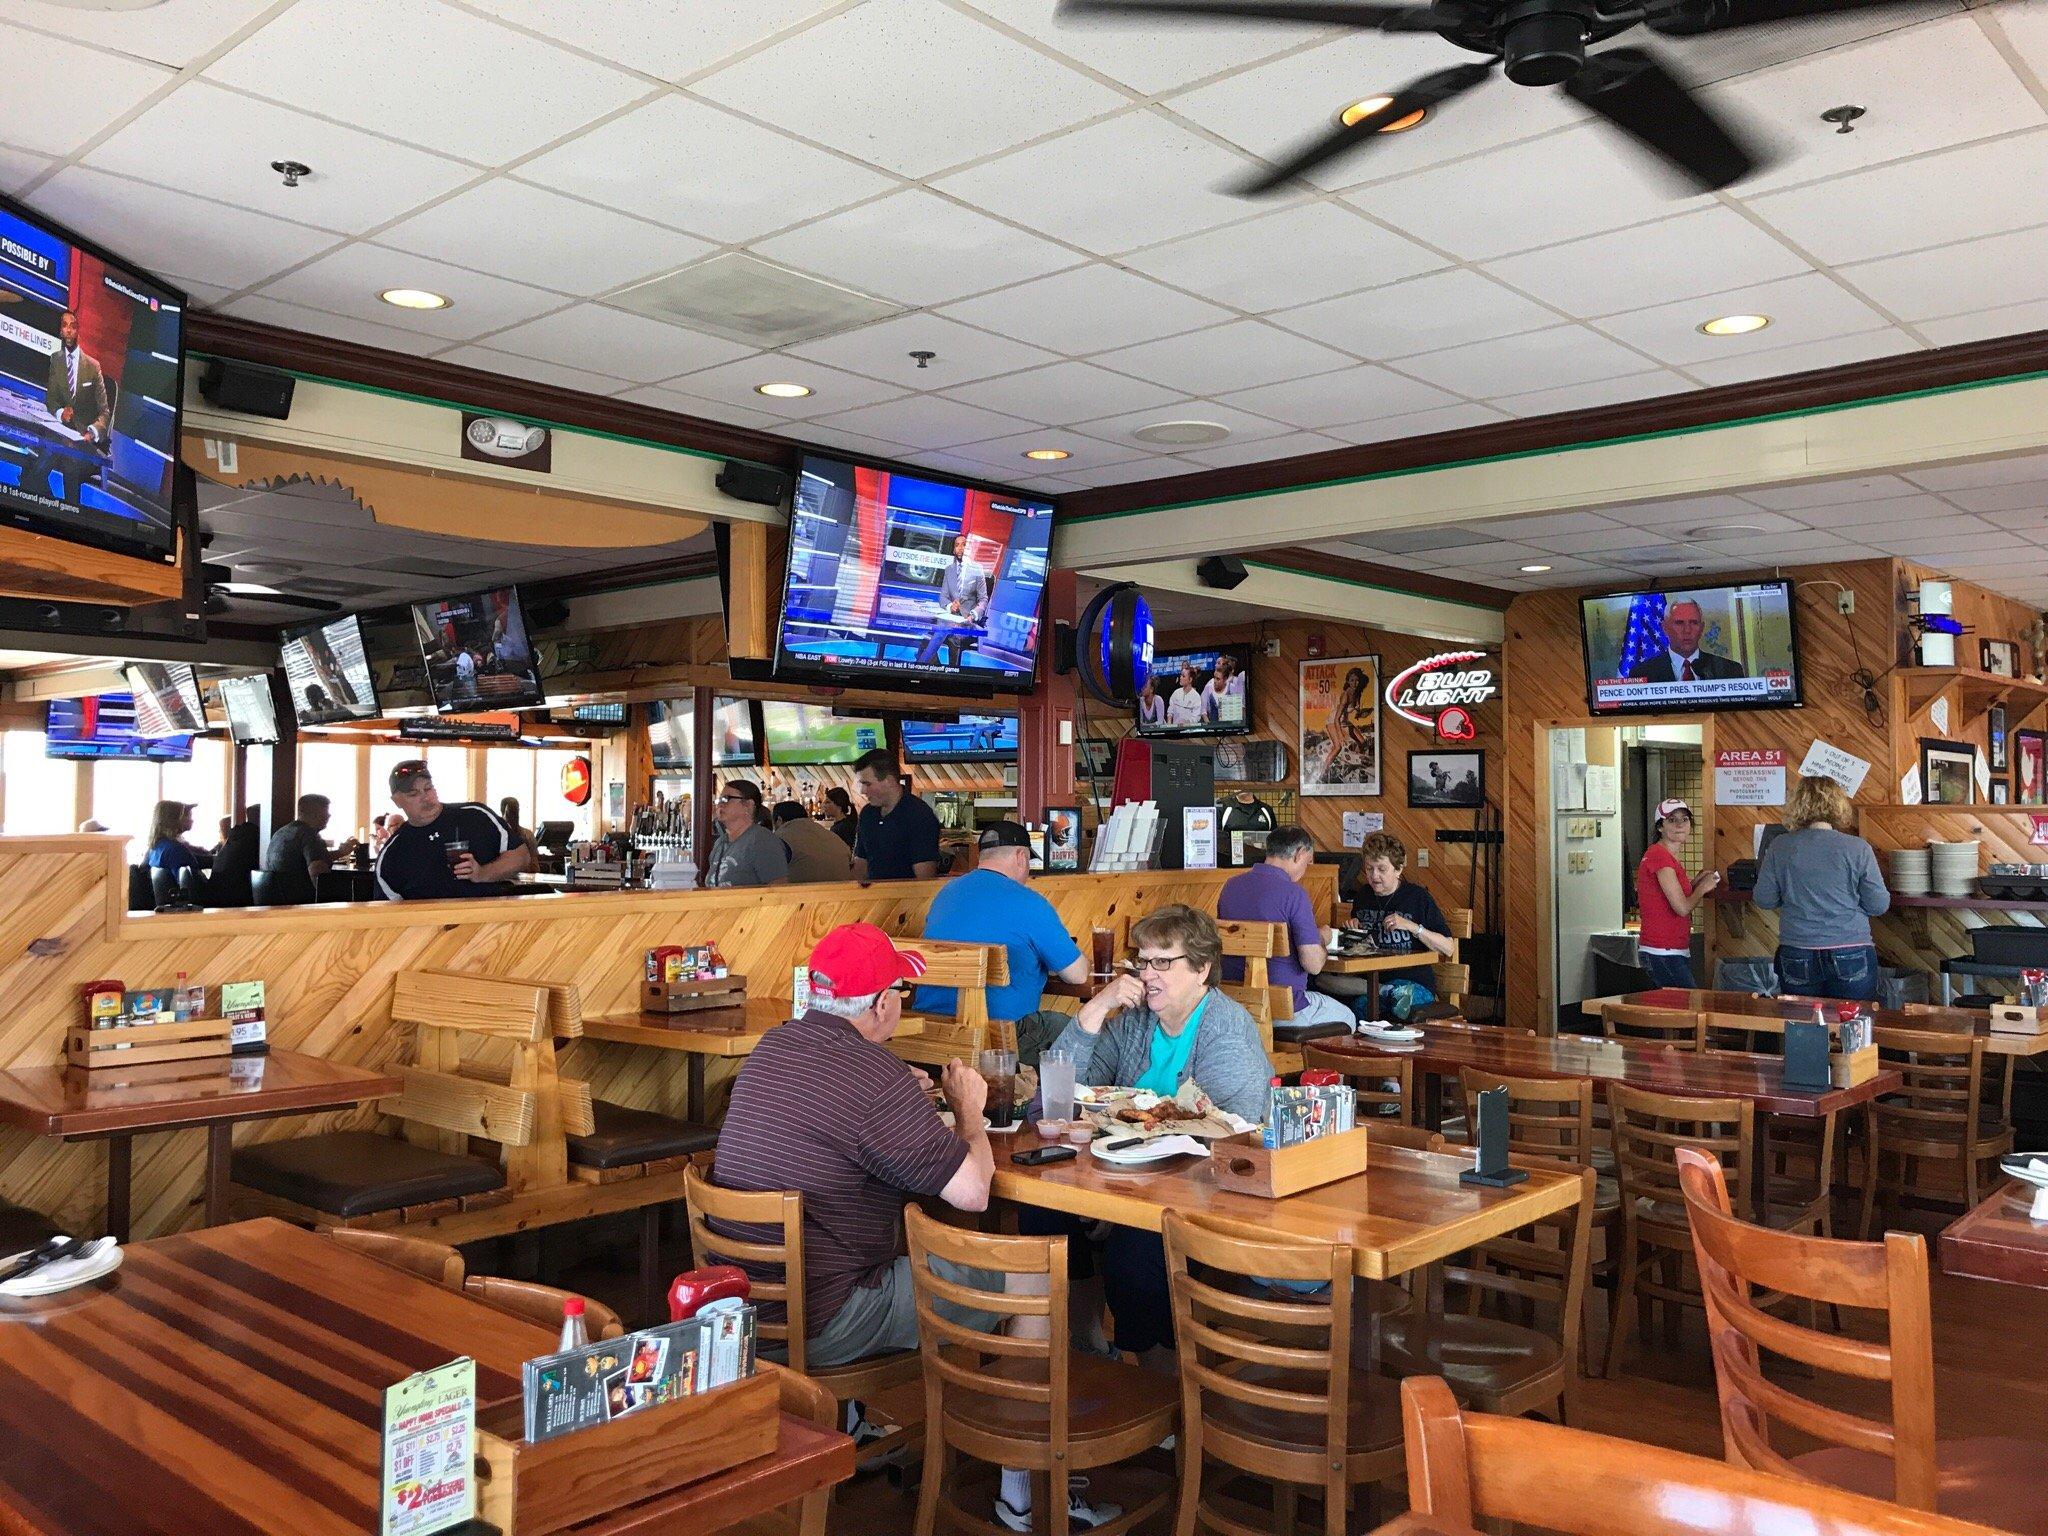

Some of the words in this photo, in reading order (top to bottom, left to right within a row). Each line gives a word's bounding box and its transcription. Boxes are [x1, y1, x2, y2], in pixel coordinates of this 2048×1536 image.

[1, 237, 37, 266] POSSIBLE
[38, 256, 49, 271] BY
[15, 326, 30, 340] THE
[30, 333, 52, 350] LINES
[2, 485, 8, 494] 8
[9, 487, 38, 502] 1st-round
[39, 496, 60, 508] playoff
[60, 502, 80, 514] games
[893, 550, 919, 561] OUTSIDE
[920, 554, 931, 563] THE
[930, 556, 947, 566] LINES
[894, 661, 903, 669] last
[929, 665, 945, 673] playoff
[1319, 680, 1330, 694] 50
[1416, 670, 1491, 690] BUD
[1769, 678, 1788, 688] CNN
[1397, 686, 1496, 706] LIGHT
[1600, 688, 1625, 698] PENCE:
[1626, 687, 1648, 696] DON'T
[1650, 686, 1668, 695] TEST
[1669, 685, 1690, 694] PRES.
[1693, 683, 1726, 693] TRUMP'S
[1728, 682, 1764, 691] RESOLVE
[1720, 751, 1761, 761] AREA
[1765, 750, 1780, 760] 51
[1805, 766, 1819, 776] WITH
[1811, 761, 1826, 770] HAVE
[1830, 769, 1854, 782] TROUBLE
[1825, 758, 1847, 771] PEOPLE
[224, 999, 262, 1010] Yuengling
[439, 1388, 467, 1404] LAGER
[398, 1416, 417, 1431] HAPPY
[418, 1410, 433, 1423] HOUR
[434, 1402, 462, 1418] SPECIALS
